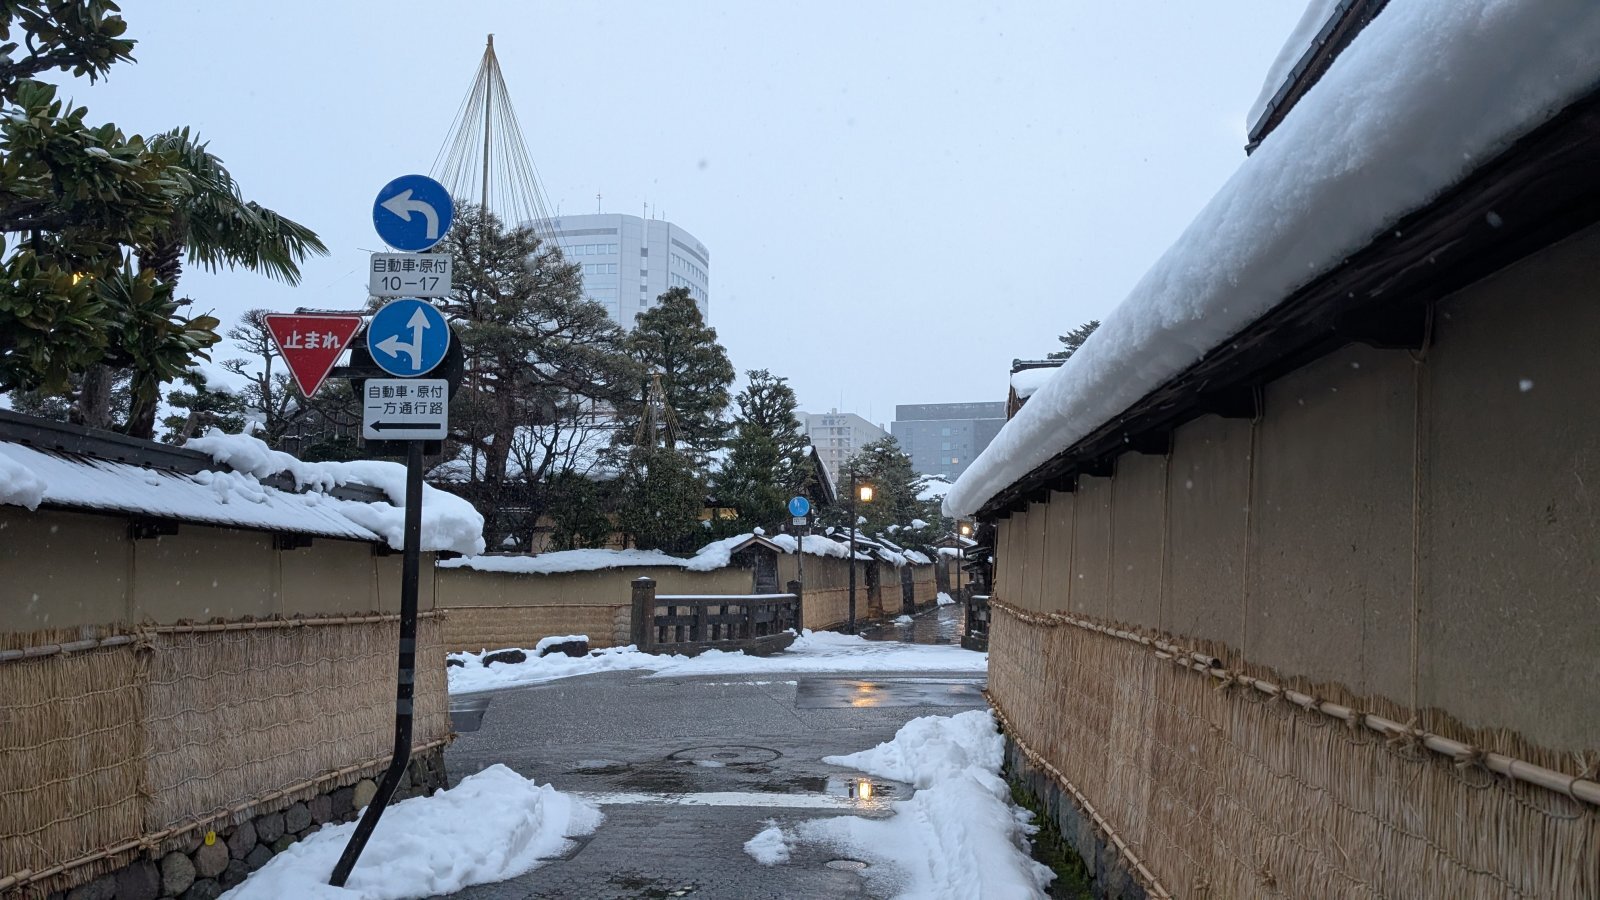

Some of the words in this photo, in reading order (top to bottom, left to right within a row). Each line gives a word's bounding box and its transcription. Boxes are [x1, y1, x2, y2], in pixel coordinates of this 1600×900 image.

[373, 258, 448, 274] 自動車・原付
[283, 330, 341, 350] 止まれ
[368, 385, 443, 399] 自動車・原付
[367, 401, 443, 415] 一方通行路
